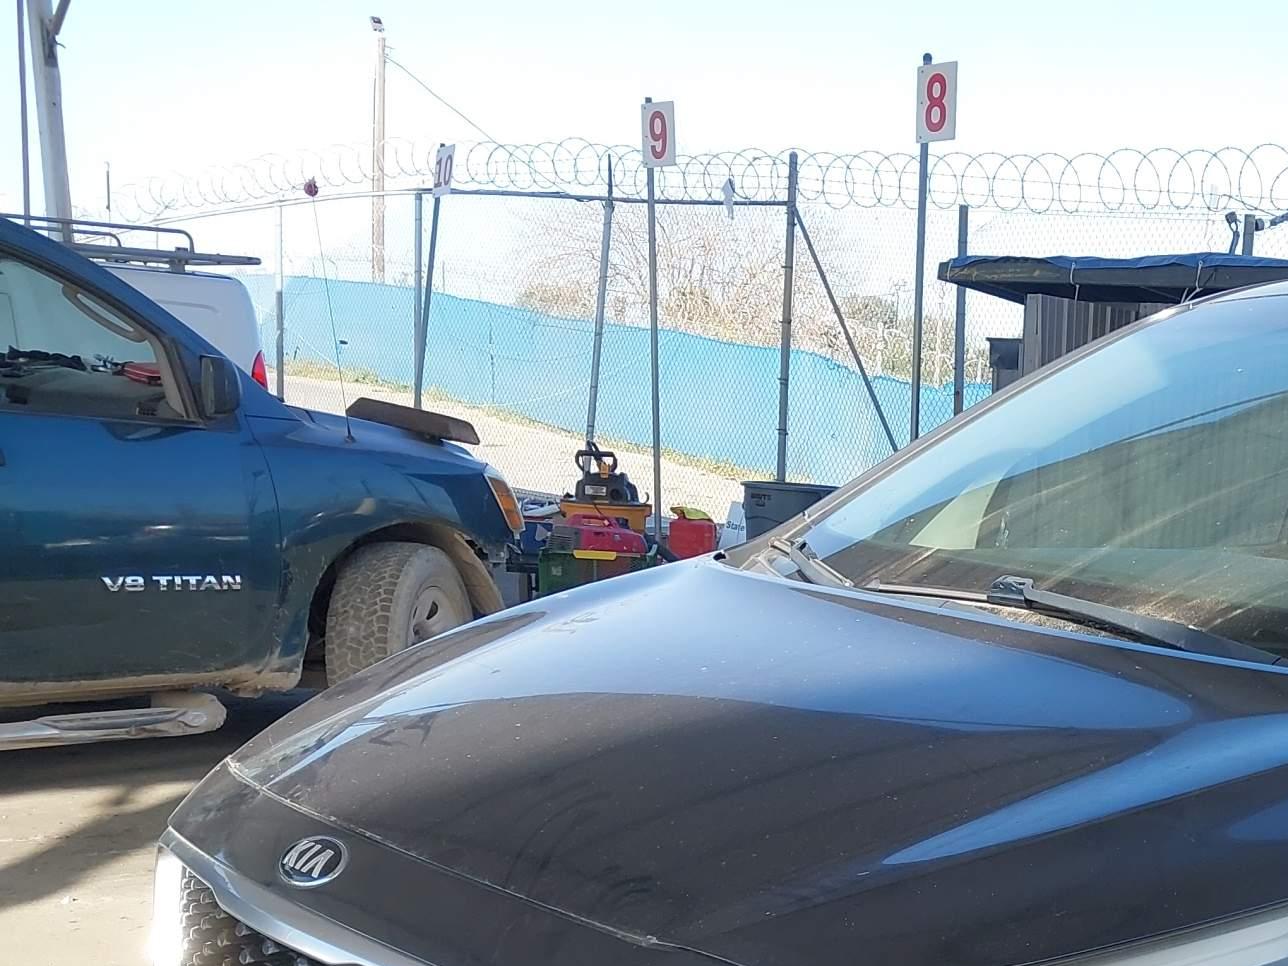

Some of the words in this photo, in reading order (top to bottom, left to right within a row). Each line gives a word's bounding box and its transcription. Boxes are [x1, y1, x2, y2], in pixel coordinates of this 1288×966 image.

[925, 72, 947, 133] 8
[649, 110, 667, 160] 9
[434, 154, 453, 188] 10
[726, 520, 745, 532] State
[101, 575, 145, 592] V8
[151, 575, 242, 591] TITAN
[282, 840, 335, 879] KIA
